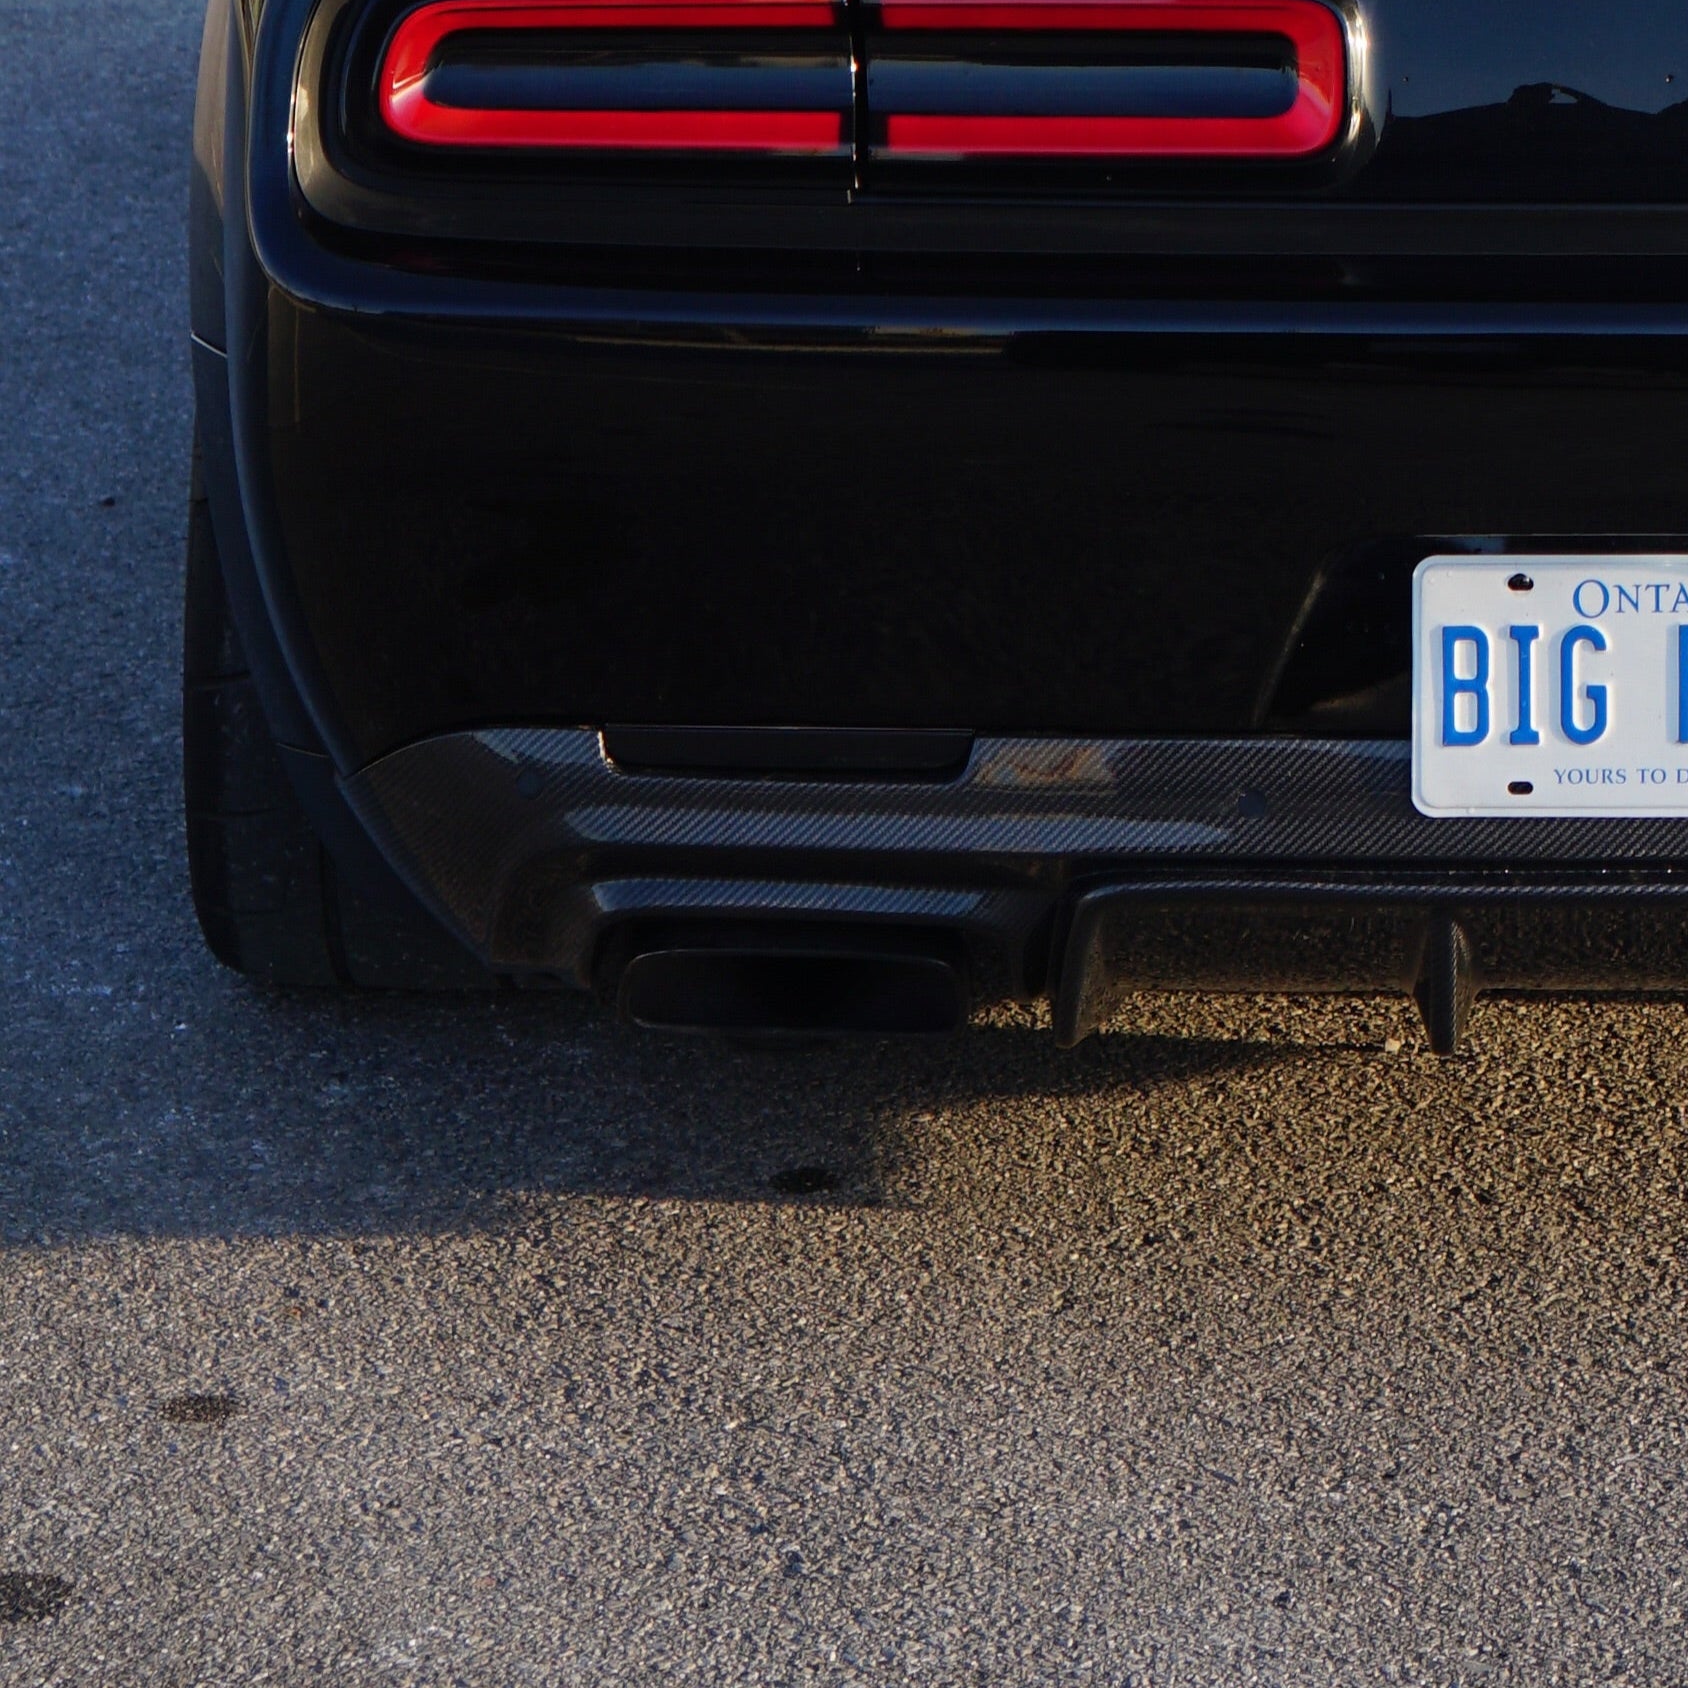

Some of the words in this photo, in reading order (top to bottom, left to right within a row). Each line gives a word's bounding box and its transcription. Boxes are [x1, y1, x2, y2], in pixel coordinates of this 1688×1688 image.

[1442, 624, 1608, 747] BIG
[1554, 768, 1627, 785] YOURS
[1637, 768, 1667, 785] TO
